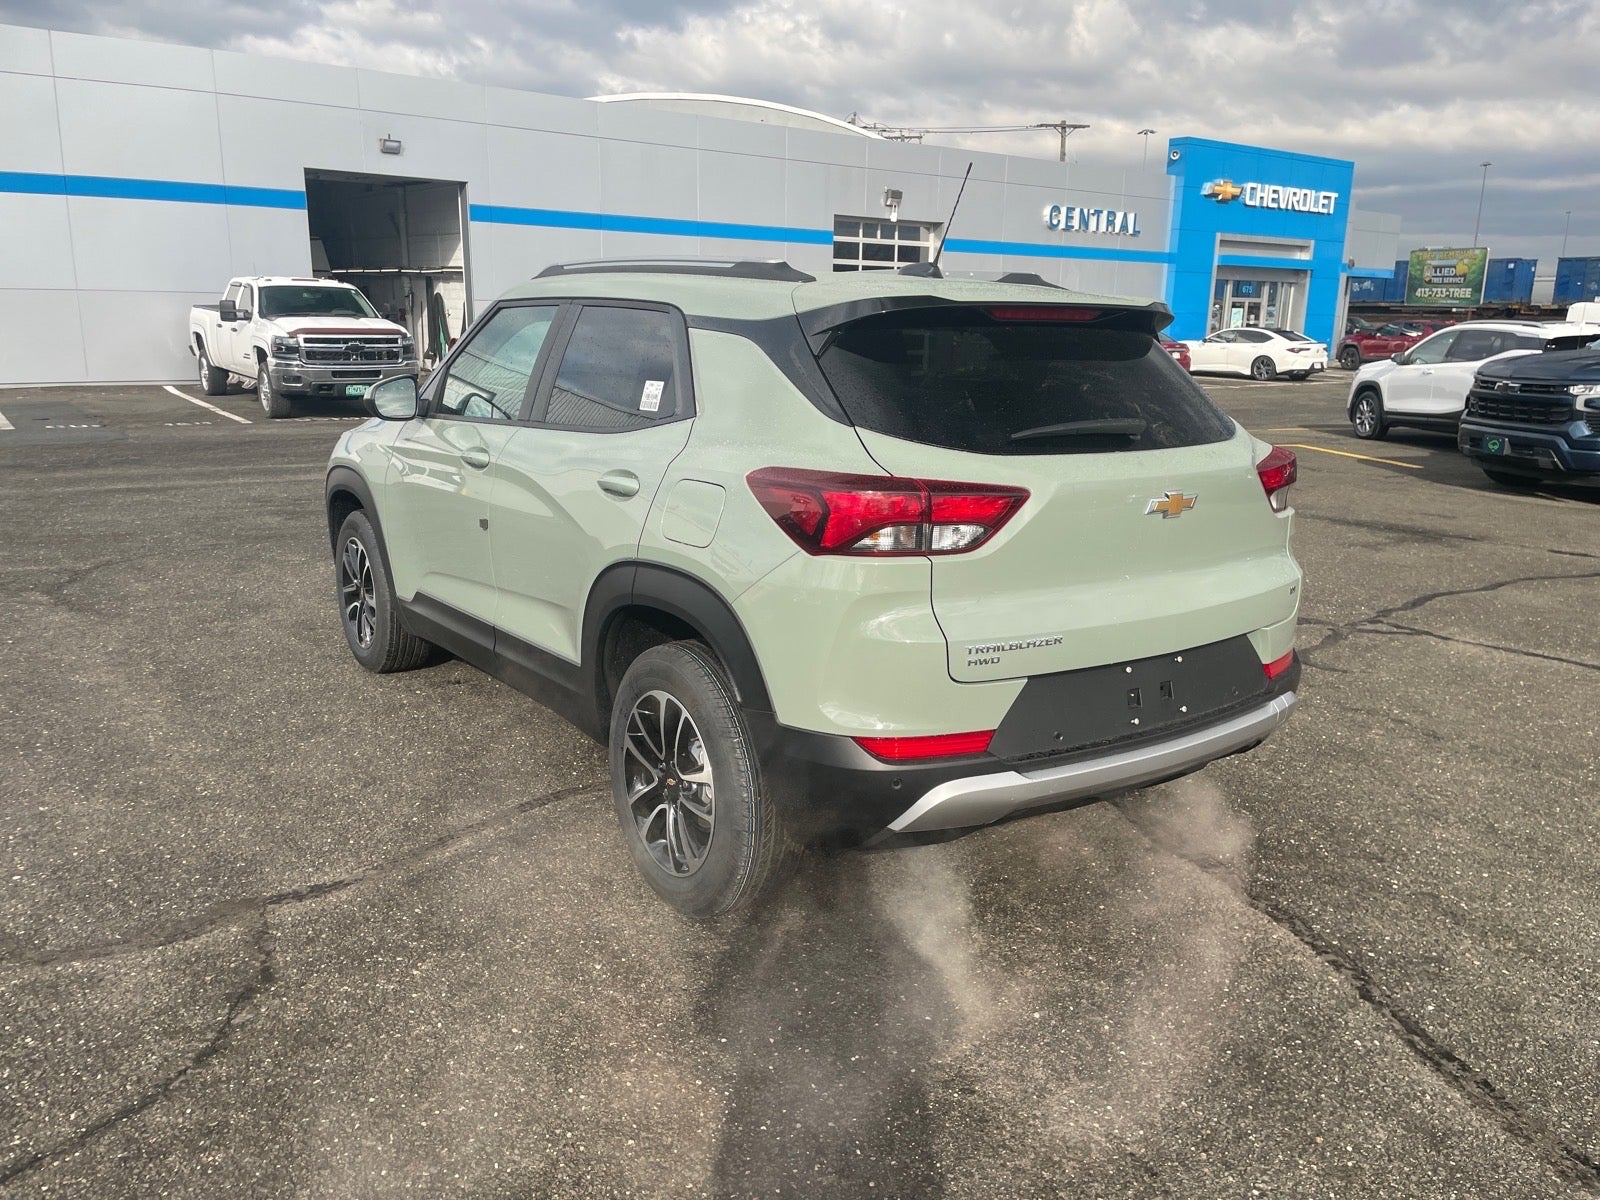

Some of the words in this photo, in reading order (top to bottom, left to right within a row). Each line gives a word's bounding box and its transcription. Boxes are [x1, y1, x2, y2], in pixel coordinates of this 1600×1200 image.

[1245, 182, 1339, 215] CHEVROLET
[1044, 204, 1141, 236] CENTRAL
[1415, 287, 1472, 298] 413-733-TREE
[966, 635, 1063, 655] TRAILBLAZER
[967, 656, 1001, 667] AWD
